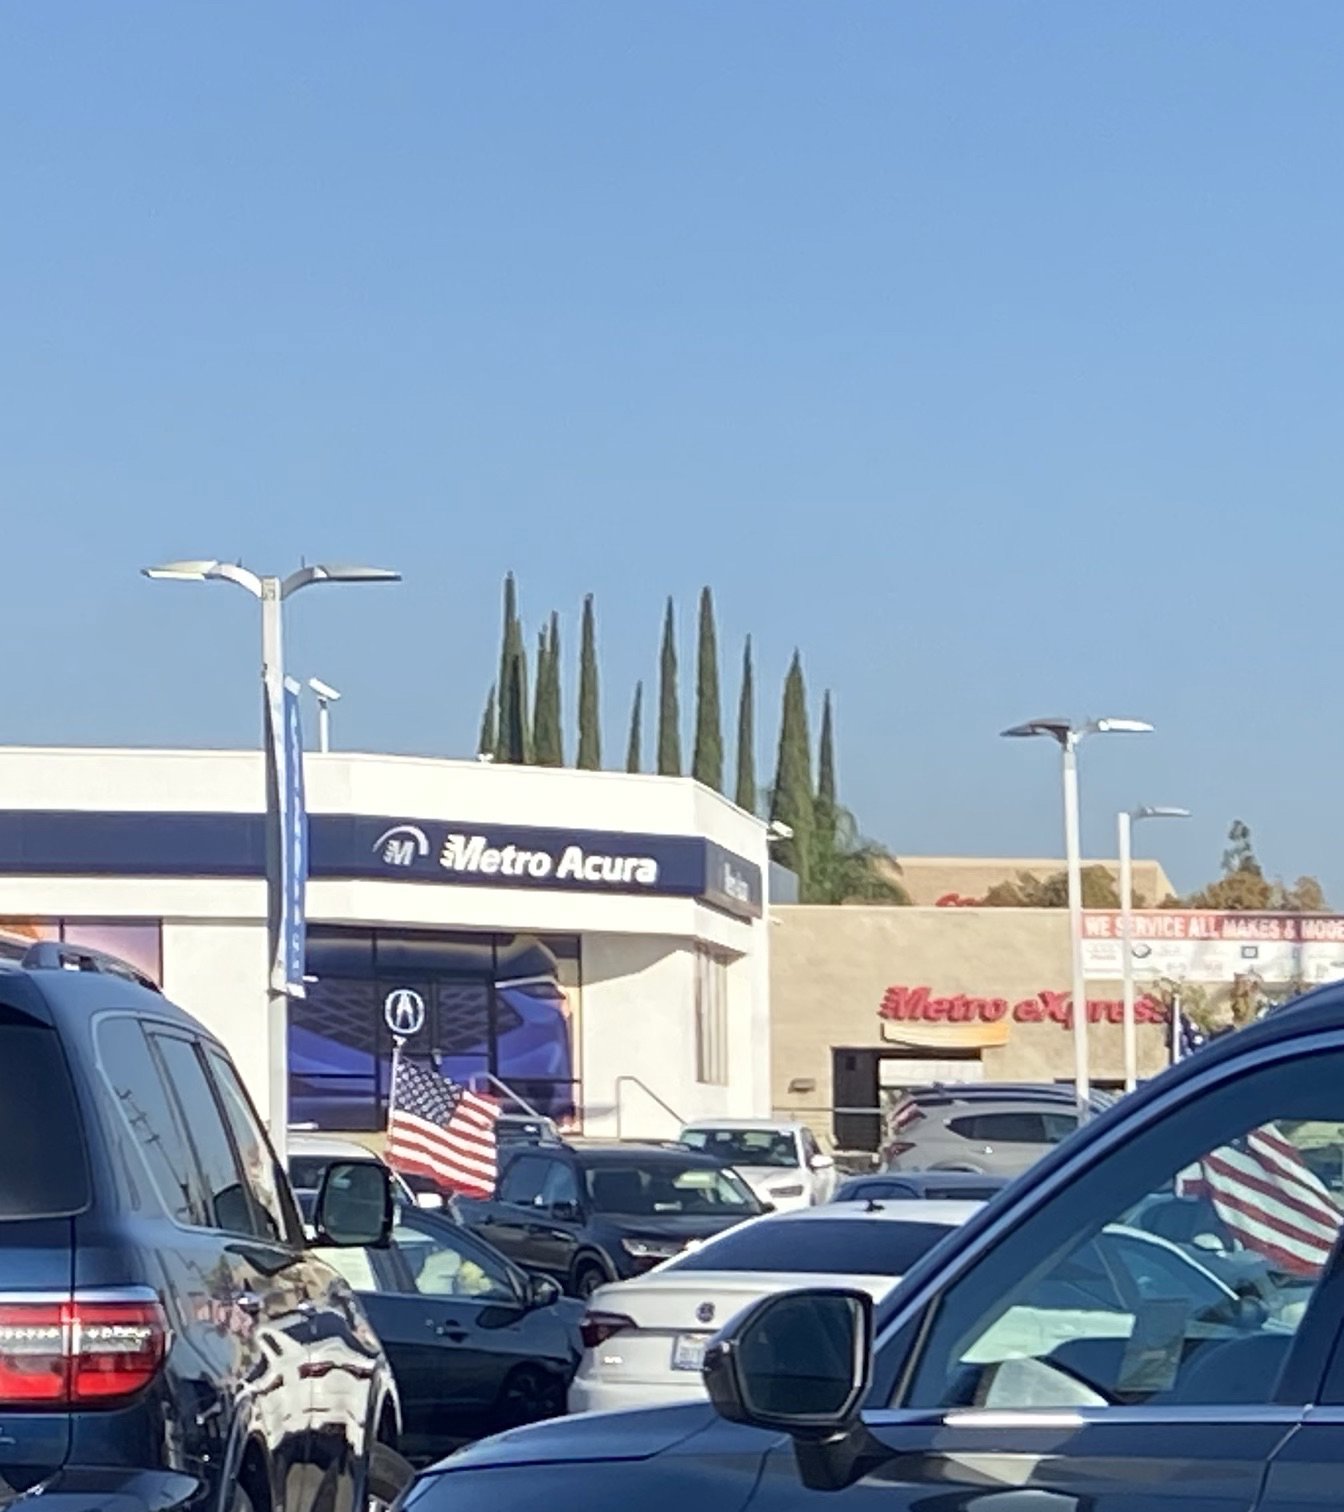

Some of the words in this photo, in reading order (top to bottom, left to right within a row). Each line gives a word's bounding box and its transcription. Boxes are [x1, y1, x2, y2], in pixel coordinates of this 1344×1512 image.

[439, 833, 552, 877] Metro
[555, 845, 658, 883] Acura
[1085, 916, 1110, 937] WE
[1188, 916, 1221, 939] ALL
[1221, 917, 1281, 940] MAKES
[1283, 918, 1296, 940] &
[878, 986, 1008, 1023] Metro
